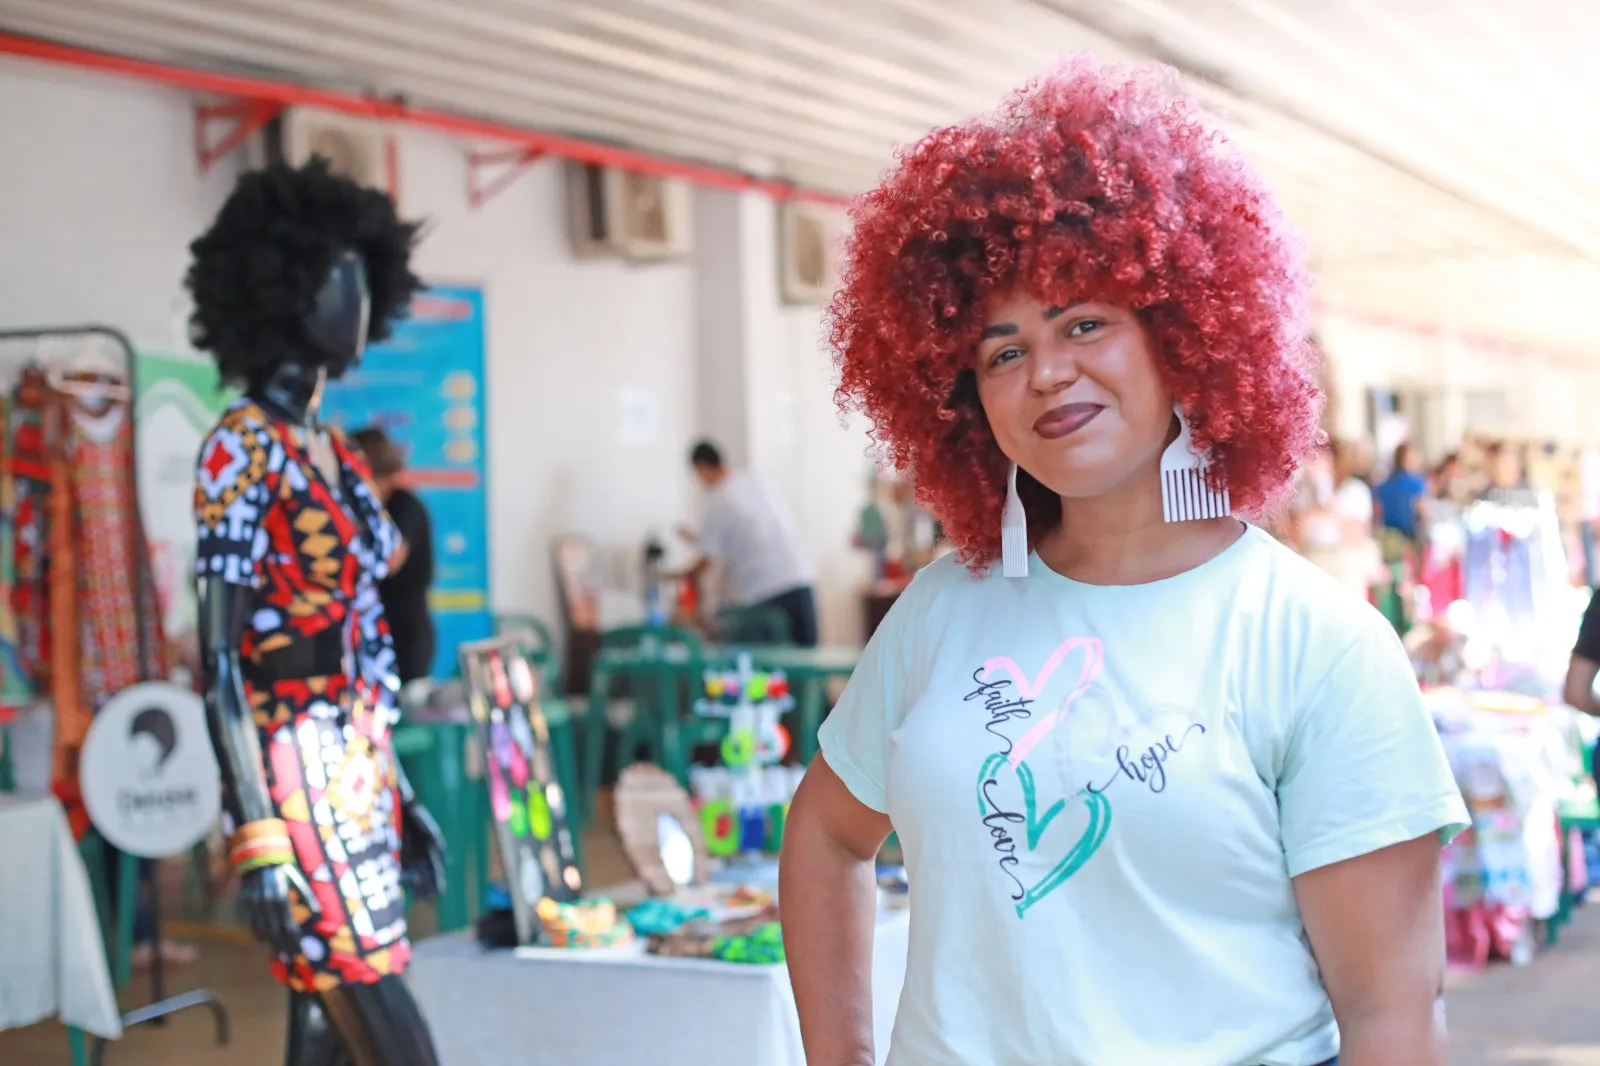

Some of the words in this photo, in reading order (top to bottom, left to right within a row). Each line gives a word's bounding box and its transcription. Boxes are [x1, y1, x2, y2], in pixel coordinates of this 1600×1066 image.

[963, 667, 1034, 755] faith
[1086, 723, 1206, 793] hope
[982, 779, 1025, 900] love
